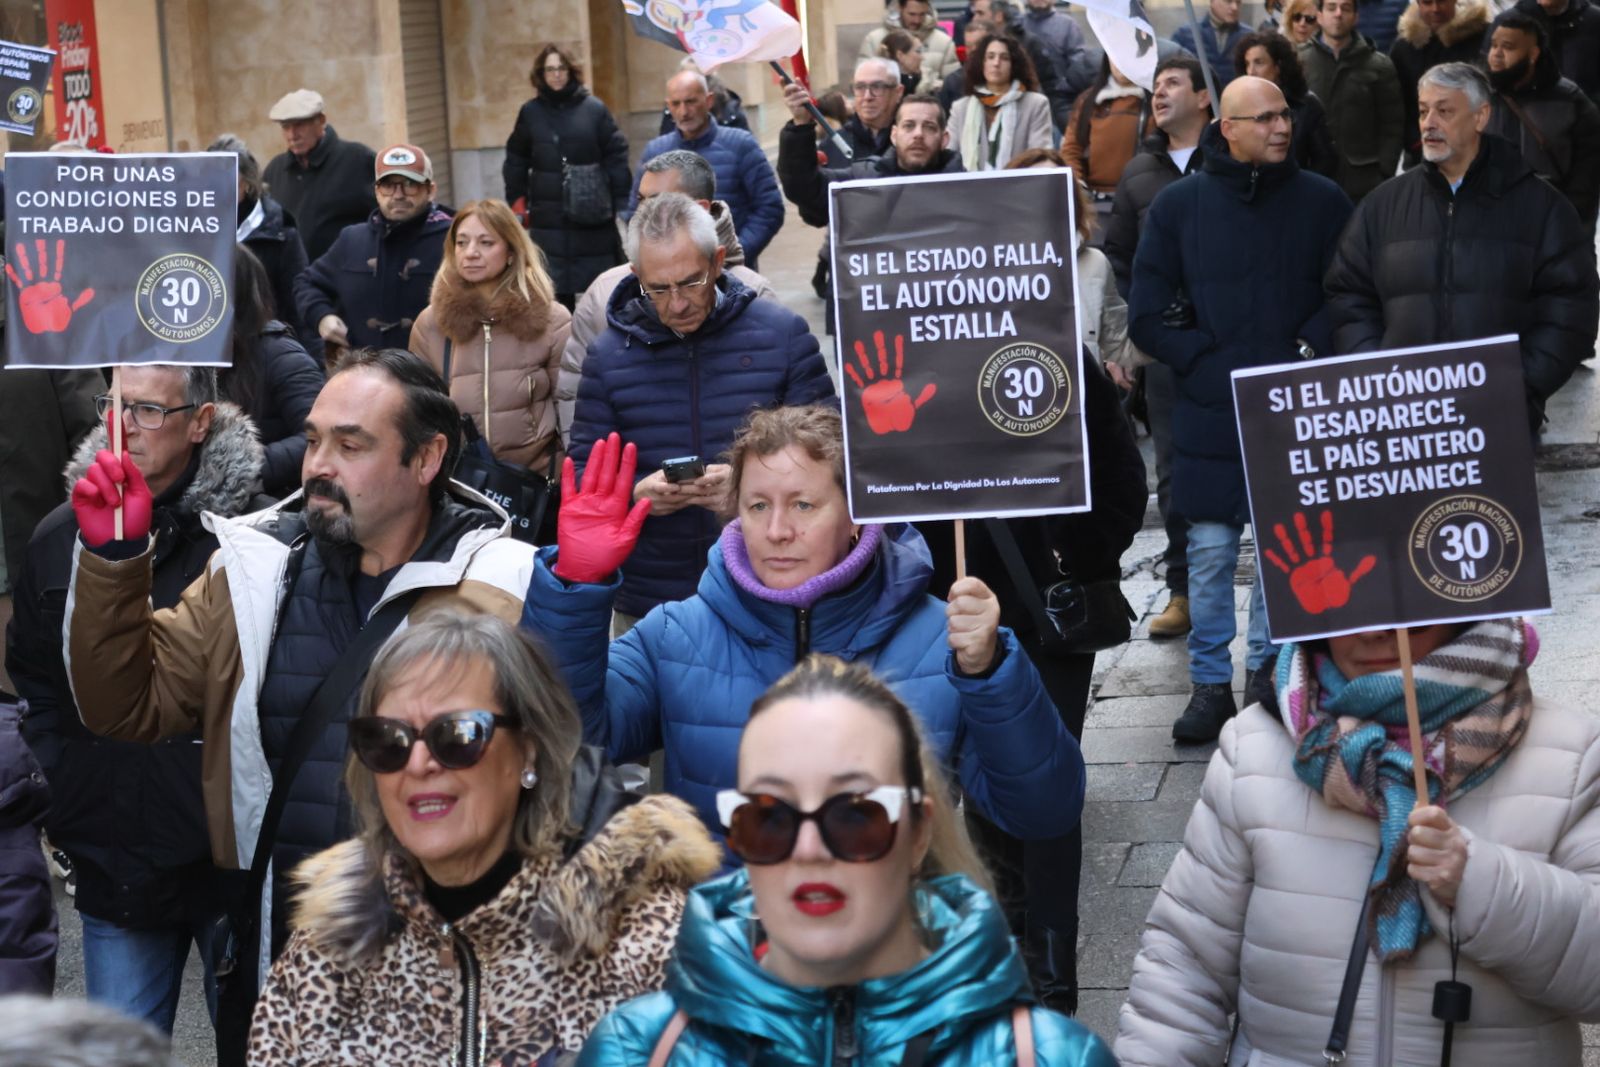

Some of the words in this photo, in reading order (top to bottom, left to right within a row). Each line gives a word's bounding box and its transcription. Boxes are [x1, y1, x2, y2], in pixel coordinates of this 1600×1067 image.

[3, 67, 32, 80] HUNDE
[64, 73, 91, 100] TODO
[17, 95, 33, 110] 30
[63, 99, 98, 148] -20%
[57, 165, 104, 182] POR
[113, 166, 176, 182] UNAS
[16, 190, 178, 208] CONDICIONES
[186, 191, 216, 207] DE
[19, 216, 125, 233] TRABAJO
[133, 216, 220, 233] DIGNAS
[849, 252, 870, 276] SI
[876, 251, 900, 275] EL
[906, 246, 988, 272] ESTADO
[993, 241, 1064, 267] FALLA,
[141, 258, 196, 296] MANIFESTACIÓN
[196, 263, 222, 300] NACIONAL
[161, 277, 201, 307] 30
[861, 284, 890, 311] EL
[895, 273, 1051, 309] AUTÓNOMO
[148, 317, 160, 329] DE
[173, 308, 188, 323] N
[910, 311, 1019, 342] ESTALLA
[983, 346, 1037, 388] MANIFESTACIÓN
[1037, 352, 1066, 390] NACIONAL
[1004, 366, 1044, 399] 30
[1268, 385, 1294, 412] SI
[1300, 381, 1330, 409] EL
[1337, 362, 1487, 404] AUTÓNOMO
[992, 410, 1005, 423] DE
[1004, 406, 1061, 432] AUTÓNOMOS
[1018, 399, 1033, 417] N
[1295, 398, 1466, 442] DESAPARECE,
[1289, 449, 1319, 475] EL
[1324, 439, 1381, 471] PAÍS
[1387, 427, 1486, 463] ENTERO
[867, 483, 915, 494] Plataforma
[916, 482, 930, 492] Por
[932, 481, 944, 490] La
[944, 479, 982, 491] Dignidad
[983, 479, 995, 488] De
[996, 478, 1011, 487] Los
[1012, 475, 1061, 486] Autonomos
[1298, 478, 1330, 506] SE
[1336, 460, 1482, 501] DESVANECE
[484, 489, 512, 508] THE
[1414, 499, 1477, 549] MANIFESTACIÓN
[1477, 504, 1516, 545] NACIONAL
[1439, 522, 1490, 561] 30
[1429, 574, 1445, 589] DE
[1444, 568, 1510, 597] AUTÓNOMOS
[1459, 560, 1477, 580] N
